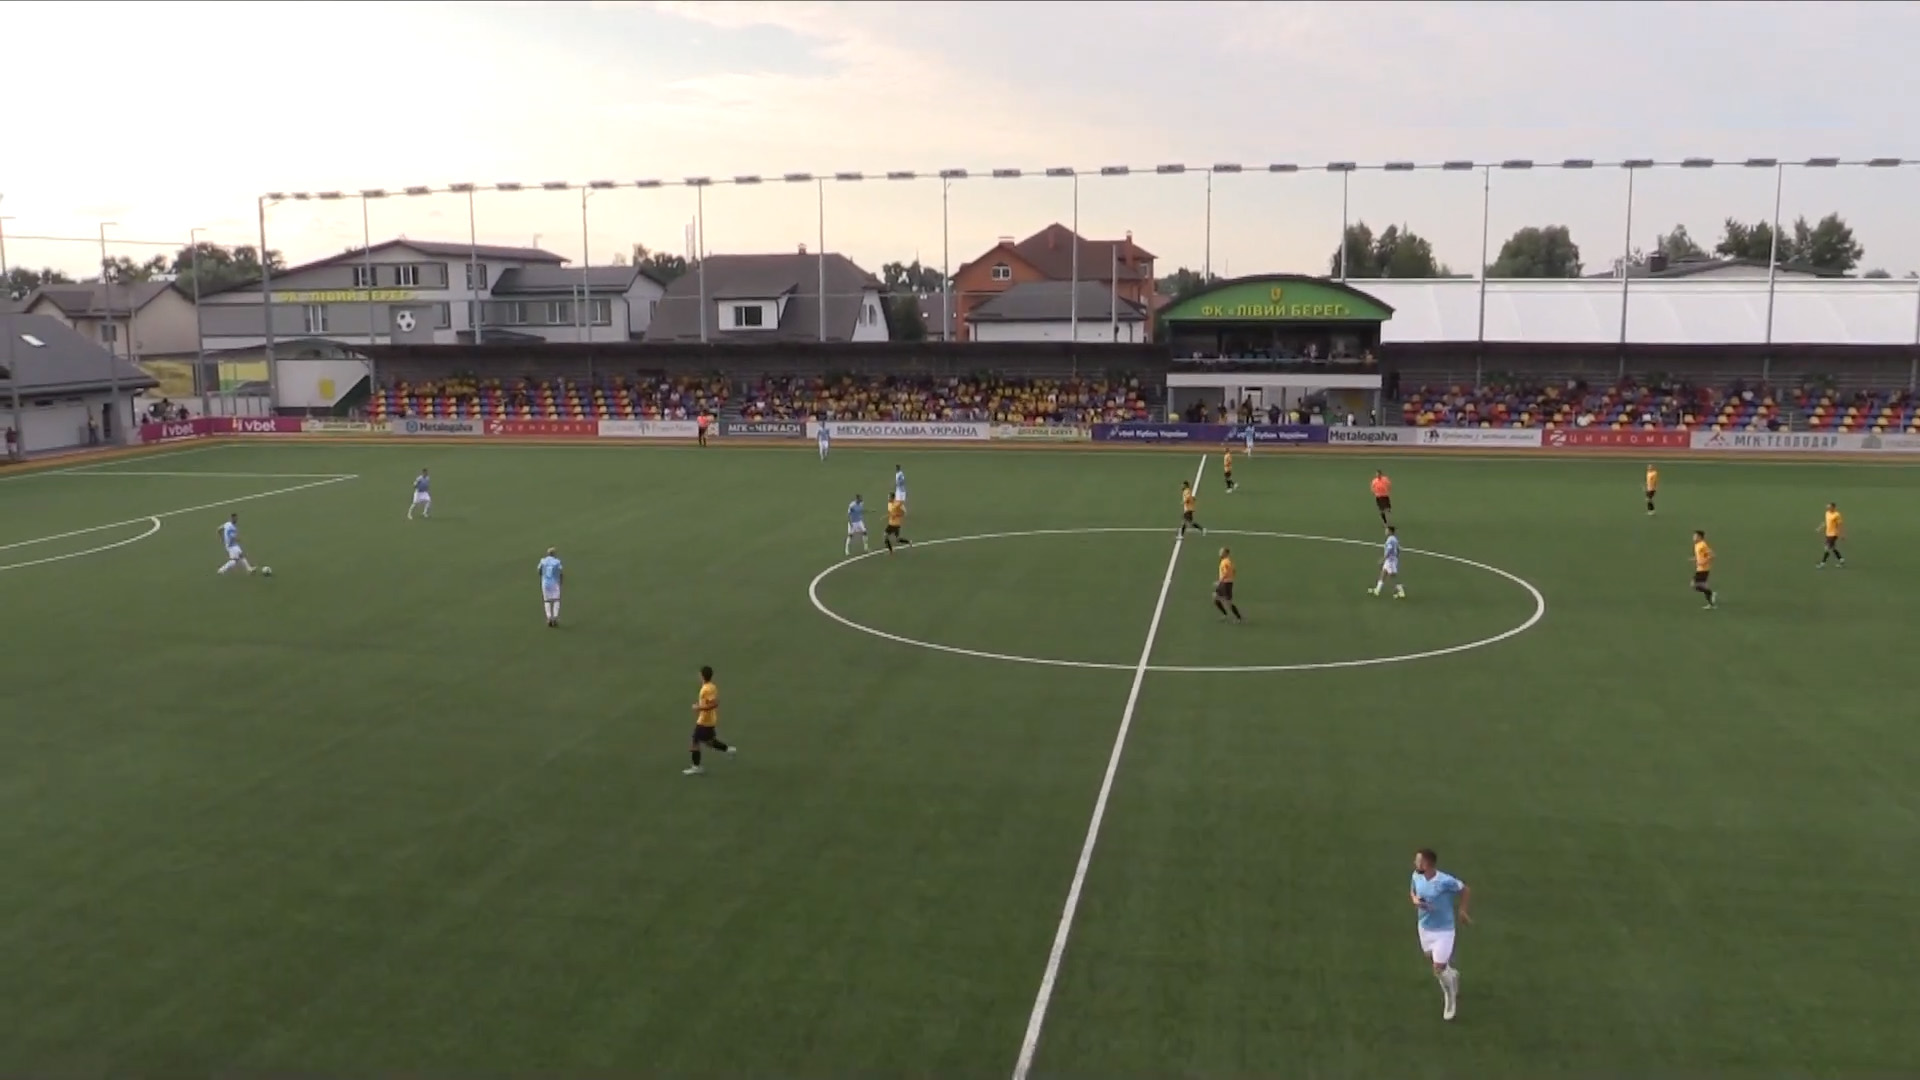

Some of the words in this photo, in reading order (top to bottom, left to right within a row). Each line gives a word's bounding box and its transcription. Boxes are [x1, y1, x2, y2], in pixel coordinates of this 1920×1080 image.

[1202, 304, 1223, 316] ФК
[168, 423, 194, 435] vbet
[245, 420, 276, 432] vbet
[1329, 430, 1398, 442] Metalogalva
